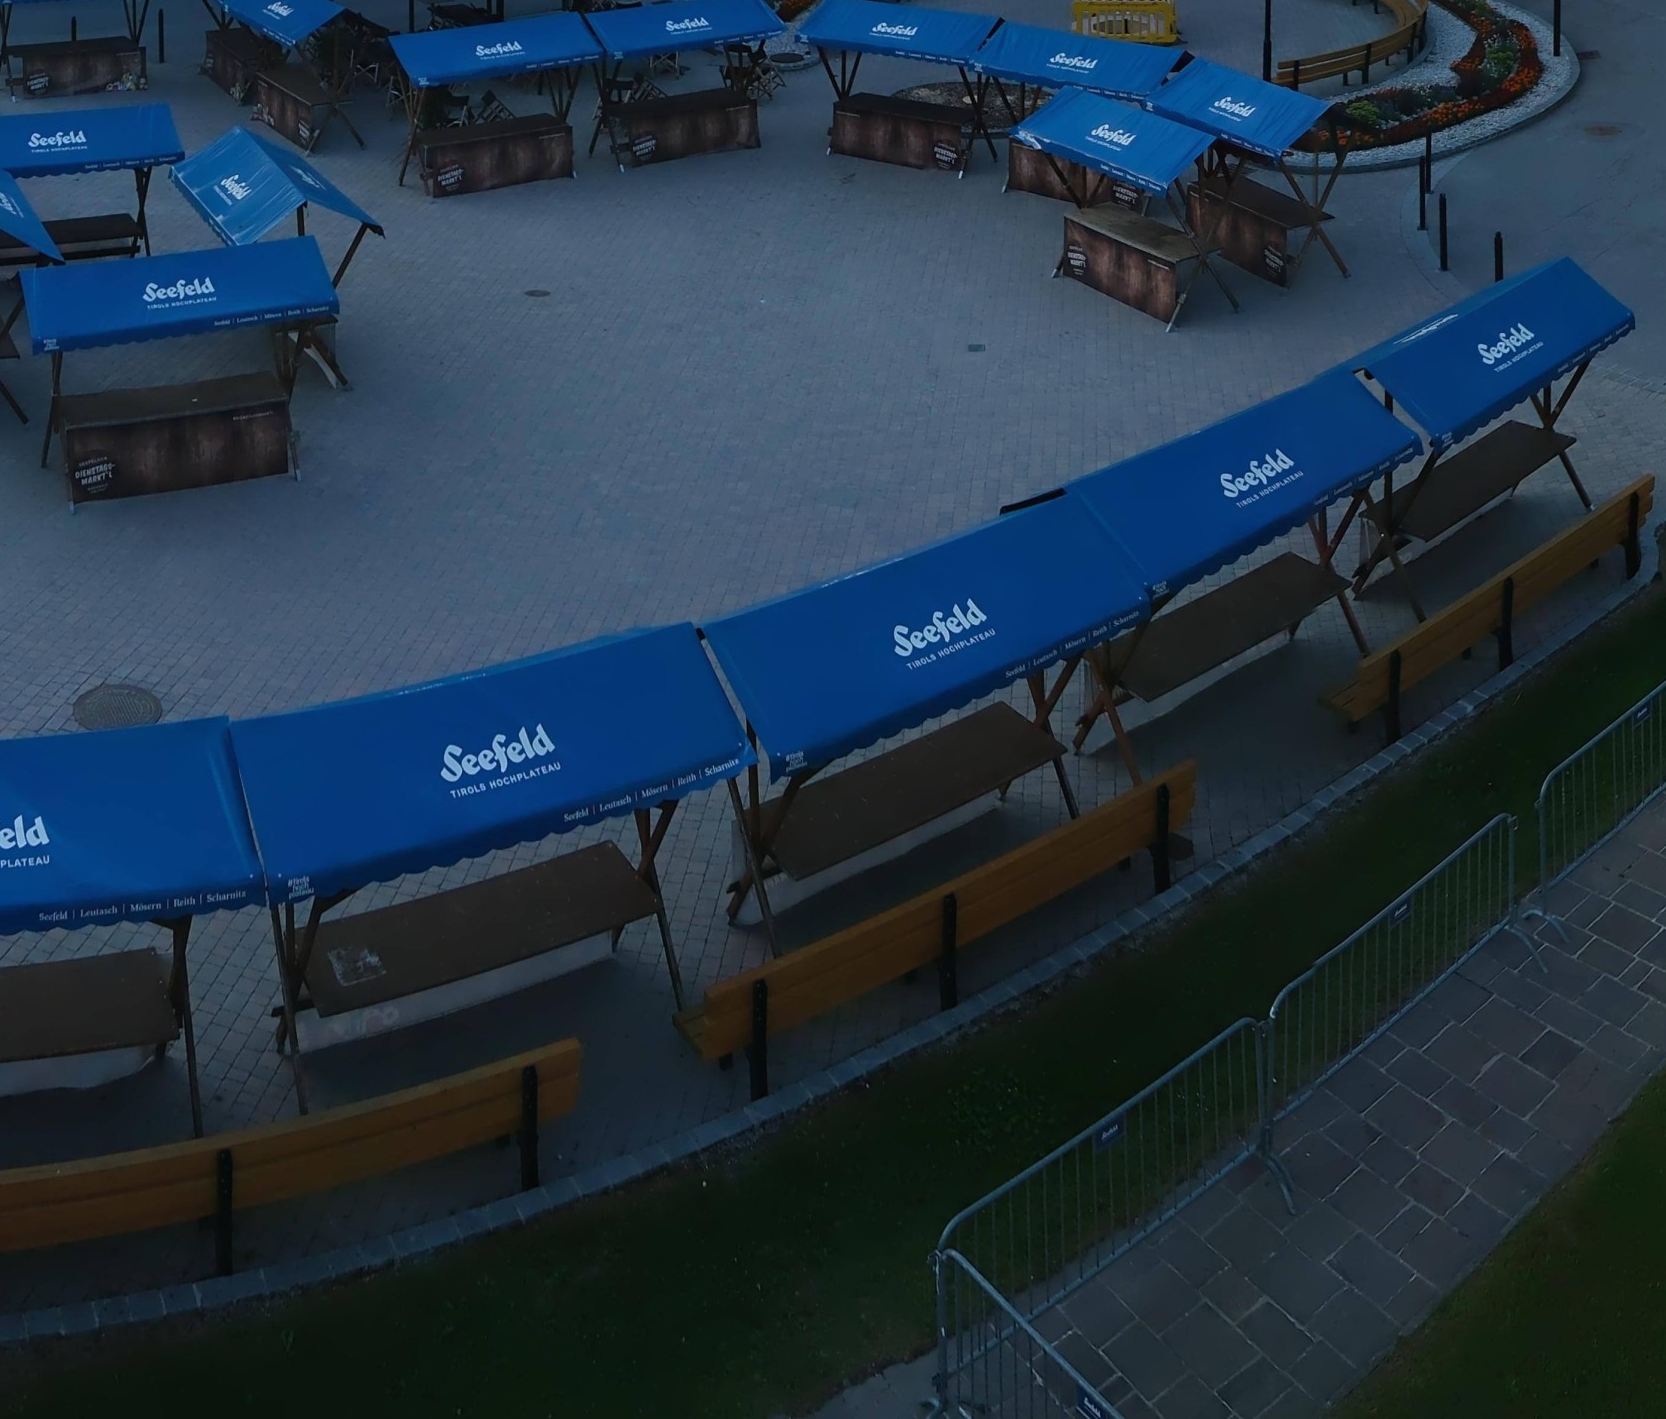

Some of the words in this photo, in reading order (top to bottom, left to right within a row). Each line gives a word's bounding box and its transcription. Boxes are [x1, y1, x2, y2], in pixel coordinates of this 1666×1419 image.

[665, 17, 709, 31] Seefeld
[871, 22, 918, 36] Seefeld
[475, 41, 523, 57] Seefeld
[1049, 52, 1098, 69] Seefeld
[1214, 96, 1257, 118] Seefeld
[27, 130, 87, 148] Seefeld
[1091, 124, 1137, 146] Seefeld
[142, 277, 215, 302] Seefeld
[1477, 322, 1535, 365] Seefeld
[74, 462, 116, 479] DIENSTAGS-
[80, 471, 113, 486] MARKT'L
[1220, 448, 1295, 498] Seefeld
[893, 598, 988, 658] Seefeld
[905, 653, 937, 671] TIROLS
[937, 628, 996, 657] HOCHPLATEAU
[440, 723, 557, 783] Seefeld
[449, 783, 487, 800] TIROLS
[489, 762, 562, 789] HOCHPLATEAU
[564, 807, 590, 822] Seefeld
[599, 795, 632, 813] Leutasch
[641, 784, 669, 800] Mösern
[678, 773, 697, 788] Reith
[705, 758, 741, 778] Scharnitz
[39, 909, 68, 922] Seefeld
[80, 904, 118, 917] Leutasch
[130, 901, 162, 914] Mösern
[173, 895, 196, 907] Reith
[205, 889, 247, 905] Scharnitz
